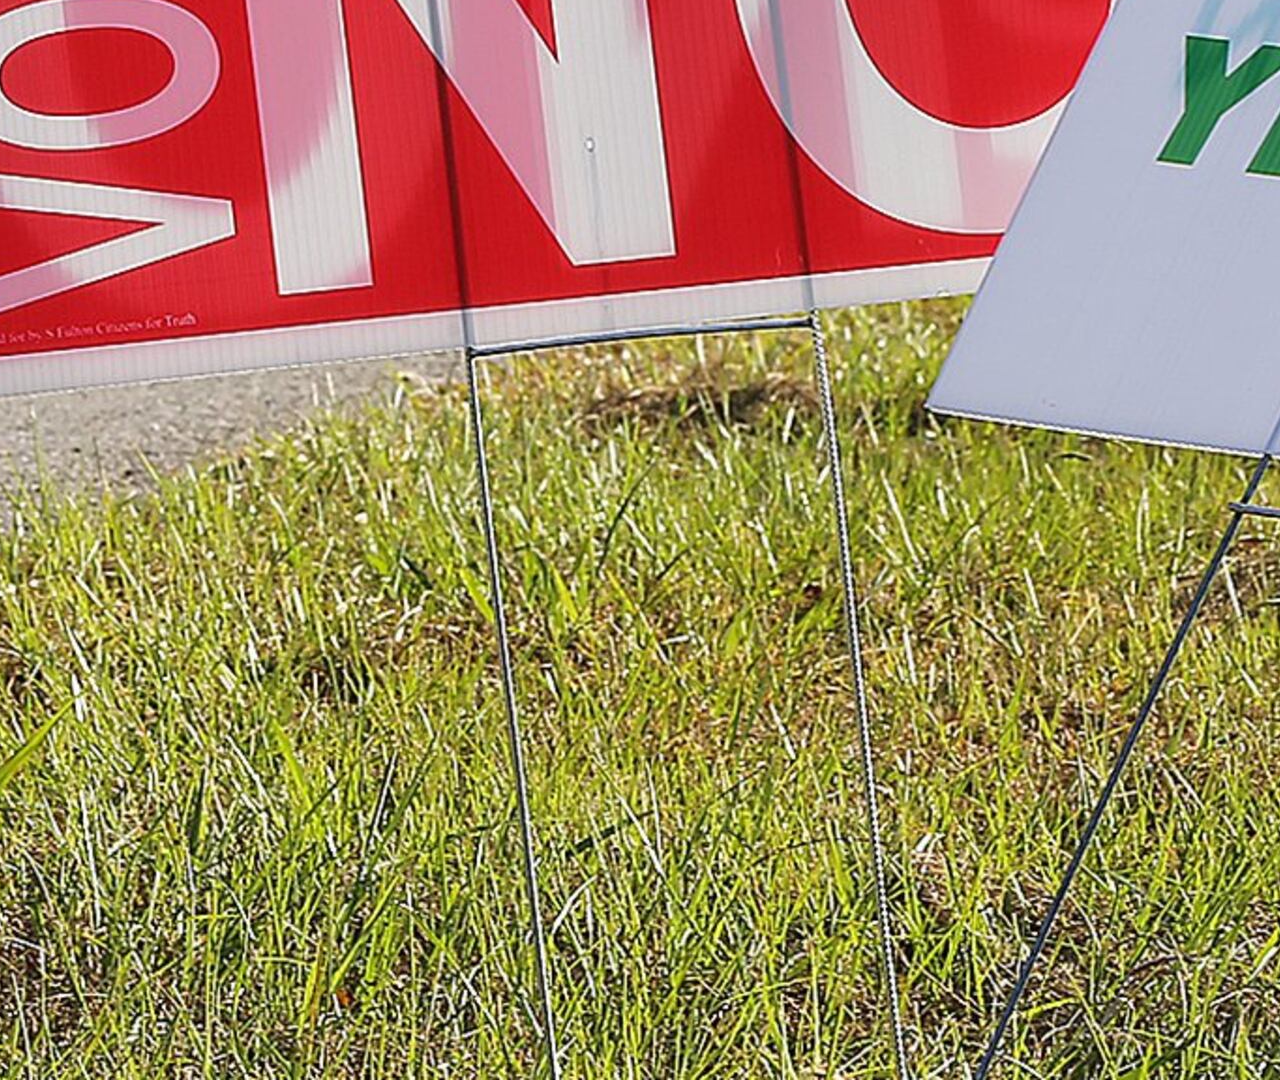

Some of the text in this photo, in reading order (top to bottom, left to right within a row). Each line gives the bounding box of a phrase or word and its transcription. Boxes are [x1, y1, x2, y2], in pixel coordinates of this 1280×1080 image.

[8, 332, 26, 344] for
[27, 329, 42, 344] by
[57, 325, 94, 339] Fulton
[95, 320, 143, 336] Citizens
[145, 317, 162, 330] for
[164, 311, 197, 328] Truth
